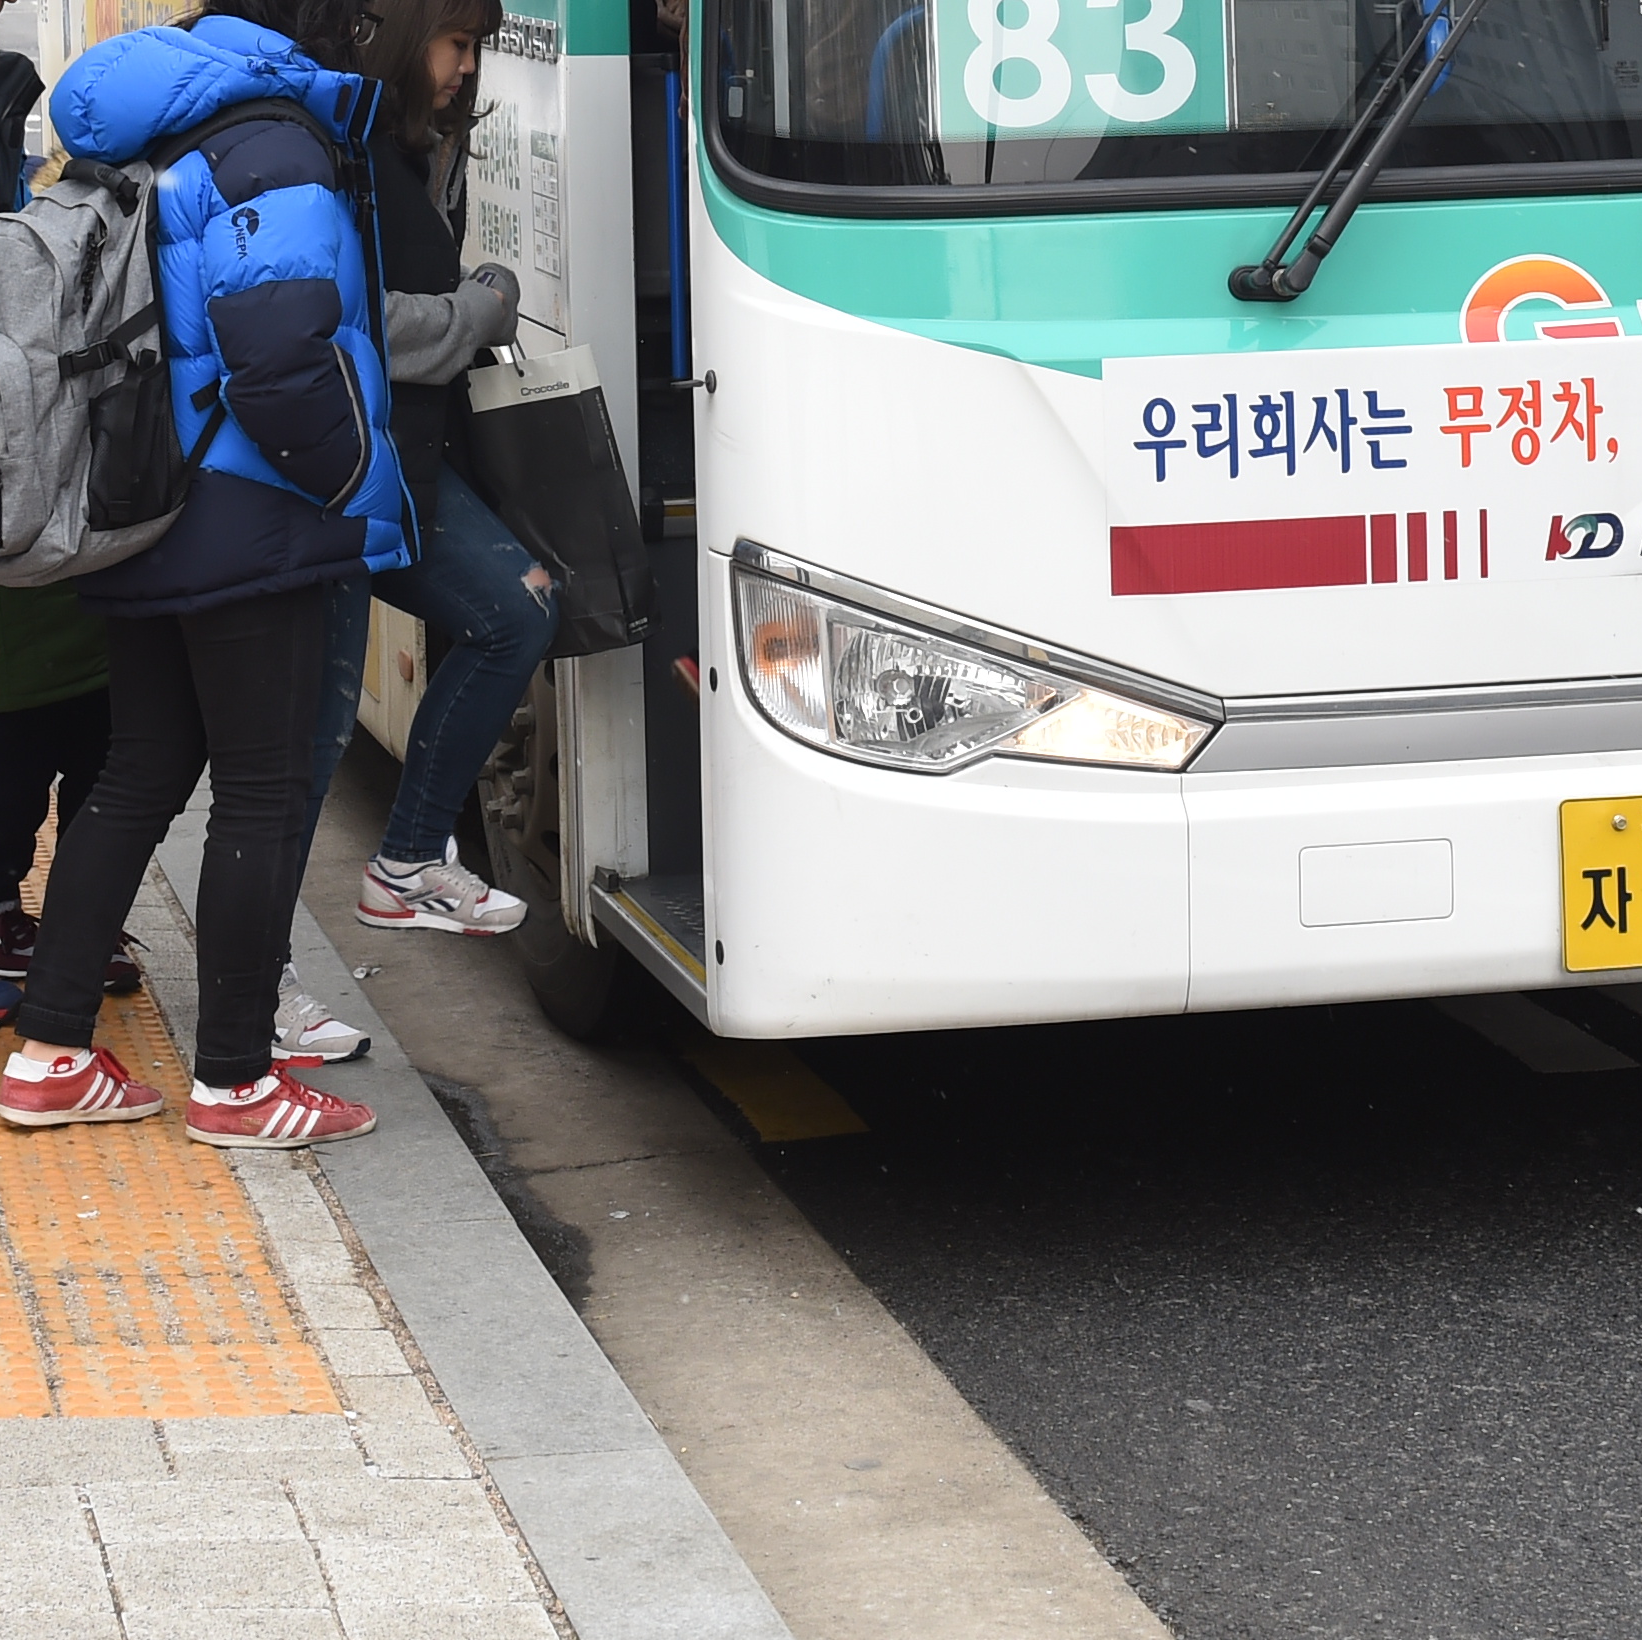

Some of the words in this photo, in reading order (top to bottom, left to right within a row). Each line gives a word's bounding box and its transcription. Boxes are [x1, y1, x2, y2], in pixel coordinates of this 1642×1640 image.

[520, 380, 570, 397] Crocodile
[1133, 388, 1413, 483] 우리회사는
[1440, 377, 1619, 468] 무정차,
